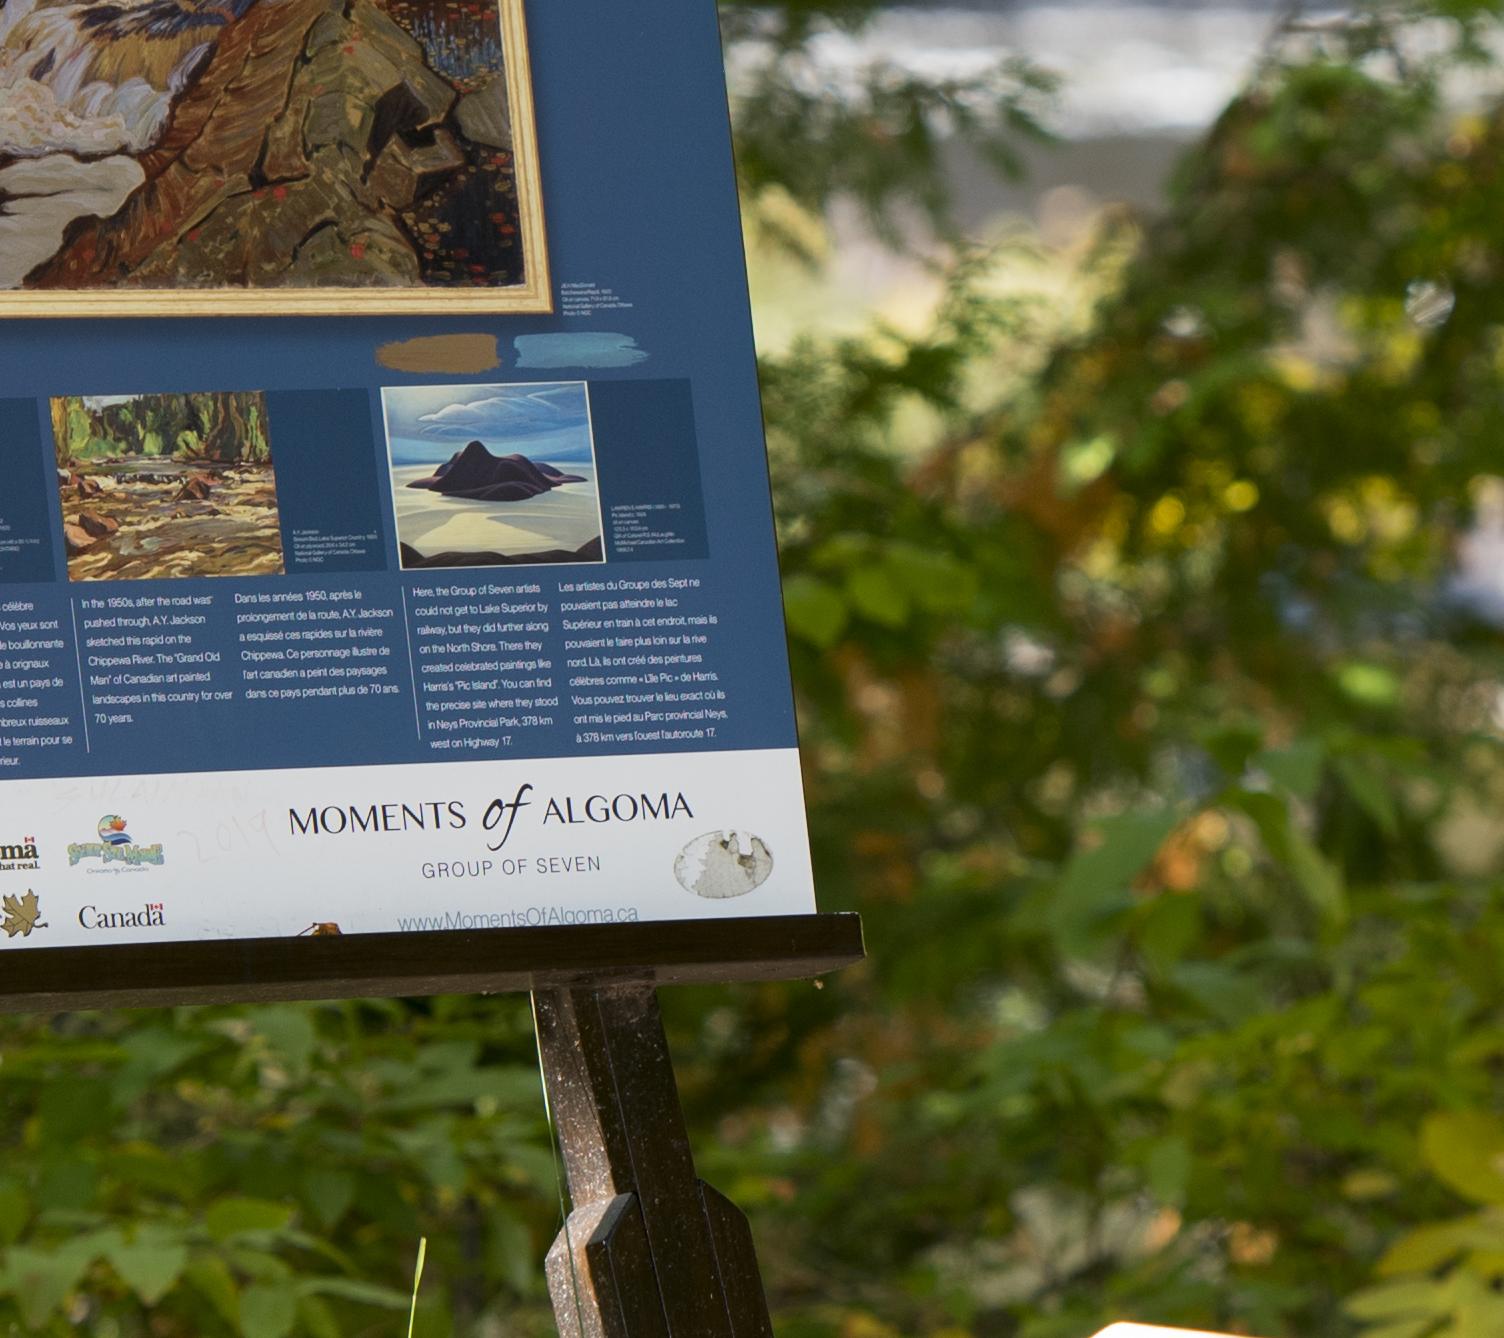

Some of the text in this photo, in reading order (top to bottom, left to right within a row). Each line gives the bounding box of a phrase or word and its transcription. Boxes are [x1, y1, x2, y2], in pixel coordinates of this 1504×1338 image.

[413, 584, 541, 597] Here, the Group of Seven artists
[558, 578, 700, 592] Les artistes du Groupe des Sept ne
[81, 599, 90, 608] In
[91, 599, 105, 608] the
[136, 597, 155, 607] after
[157, 597, 171, 606] the
[171, 596, 192, 606] road
[289, 784, 693, 851] MOMENTS of ALGOMA
[17, 860, 41, 870] real.
[422, 856, 600, 878] GROUP OF SEVEN
[79, 904, 165, 929] Canada
